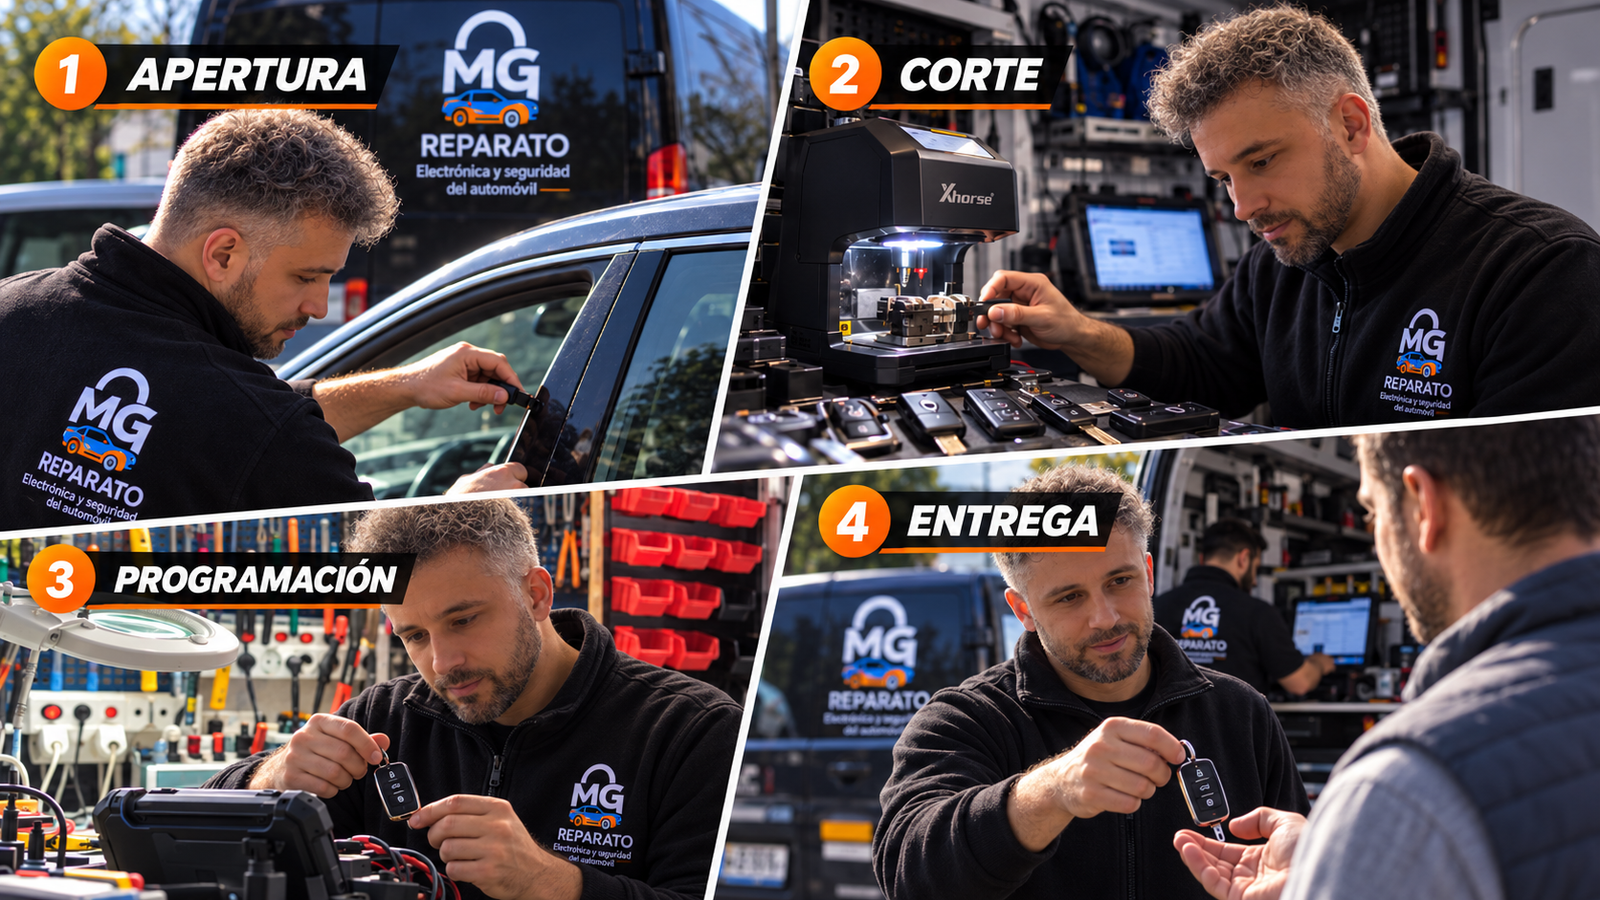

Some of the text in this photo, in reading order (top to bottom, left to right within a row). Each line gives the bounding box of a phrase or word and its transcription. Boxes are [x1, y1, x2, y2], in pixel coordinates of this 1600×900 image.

[442, 47, 540, 101] MG
[420, 133, 570, 158] REPARATO
[416, 163, 570, 181] Electrónica y seguridad
[446, 181, 537, 195] del automóvil
[1398, 328, 1447, 362] MG
[1384, 375, 1453, 398] REPARATO
[68, 386, 158, 455] MG
[37, 451, 144, 507] REPARATO
[22, 472, 138, 522] Electrónica y seguridad
[46, 497, 62, 511] del
[1182, 607, 1221, 627] MG
[842, 625, 918, 668] MG
[828, 690, 930, 711] REPARATO
[570, 783, 625, 814] MG
[557, 827, 633, 849] REPARATO
